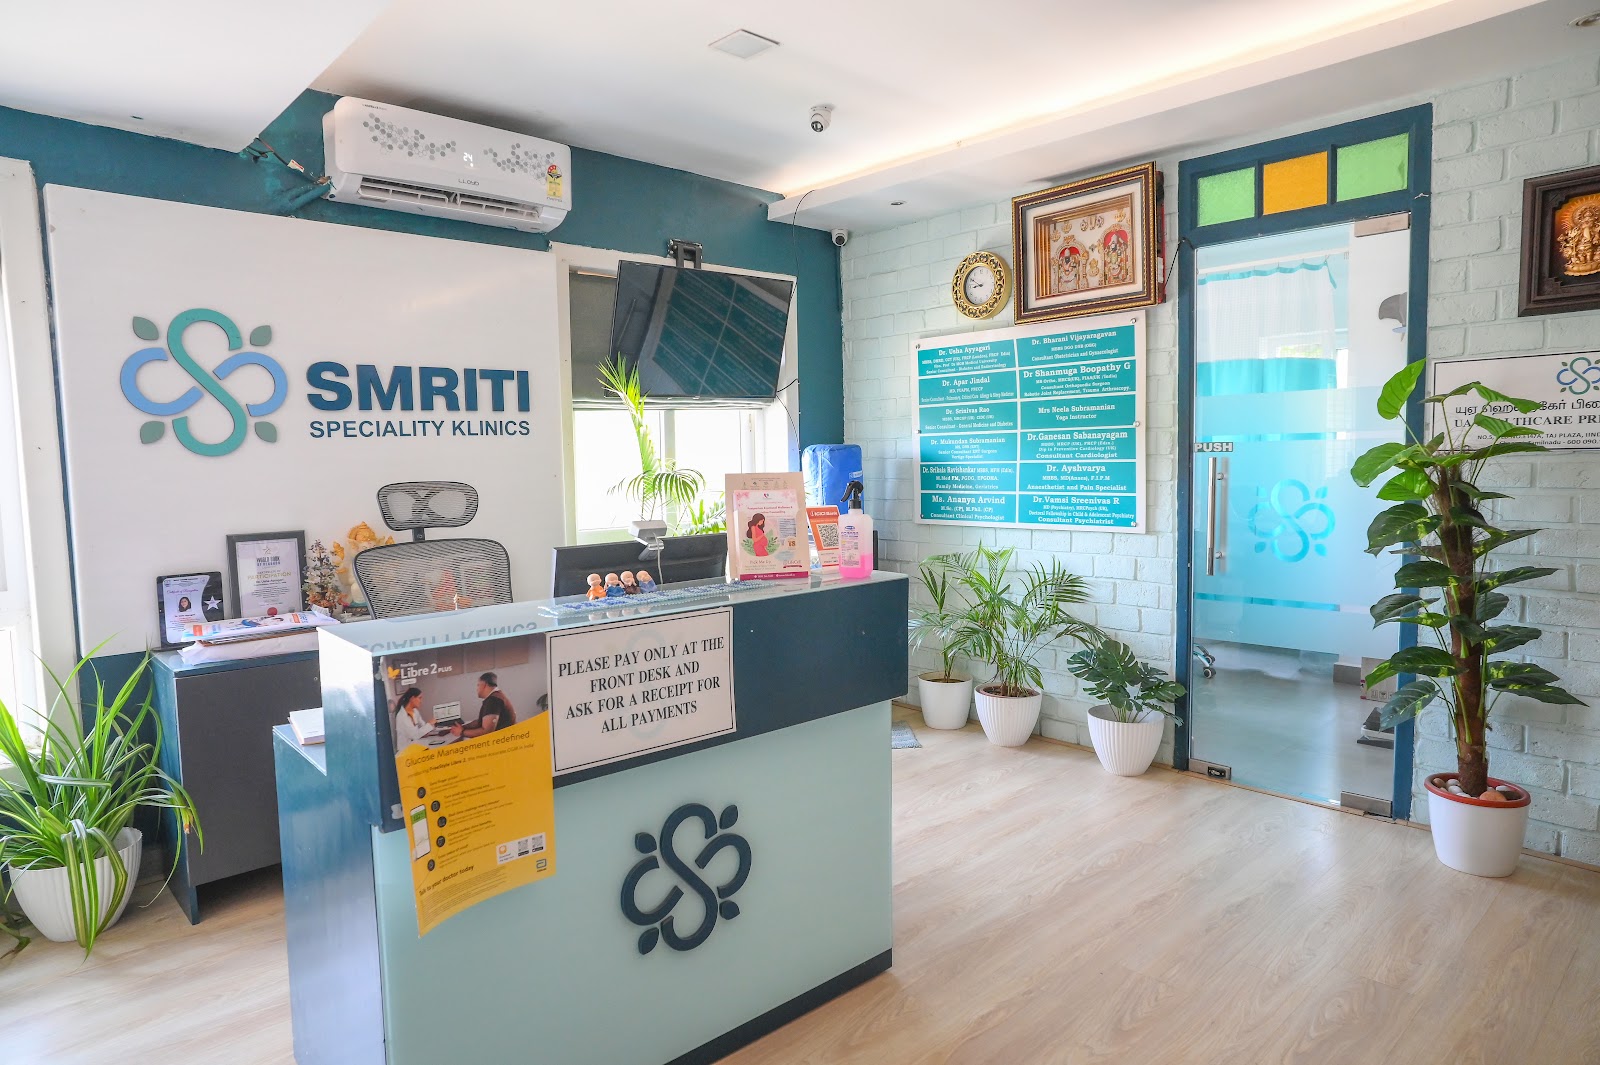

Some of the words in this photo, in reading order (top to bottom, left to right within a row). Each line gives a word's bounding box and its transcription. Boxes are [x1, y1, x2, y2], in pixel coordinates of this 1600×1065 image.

[463, 152, 473, 162] 24
[1070, 331, 1116, 341] Vijayaragavan
[965, 344, 990, 353] Ayyagari
[1035, 369, 1077, 377] Shanmuga
[1080, 364, 1121, 374] Boopathy
[306, 361, 530, 412] SMRITI
[309, 421, 444, 438] SPECIALITY
[452, 421, 530, 436] KLINICS
[1074, 432, 1128, 440] Sabanayagam
[1194, 443, 1232, 452] PUSH
[1061, 464, 1106, 473] Ayshvarya
[947, 496, 976, 504] Ananya
[558, 656, 610, 677] PLEASE
[614, 651, 639, 667] PAY
[644, 644, 678, 662] ONLY
[682, 642, 697, 655] AT
[701, 636, 724, 652] THE
[401, 667, 429, 679] Libre
[430, 663, 437, 674] 2
[590, 673, 634, 693] FRONT
[639, 666, 671, 684] DESK
[676, 661, 699, 676] AND
[566, 701, 593, 719] ASK
[598, 696, 624, 713] FOR
[629, 694, 637, 706] A
[642, 682, 693, 704] RECEIPT
[698, 676, 720, 692] FOR
[602, 717, 627, 733] ALL
[632, 701, 697, 726] PAYMENTS
[405, 754, 435, 767] Glucose
[437, 740, 490, 758] Management
[493, 731, 530, 745] redefined
[443, 872, 458, 882] doctor
[460, 866, 474, 874] today
